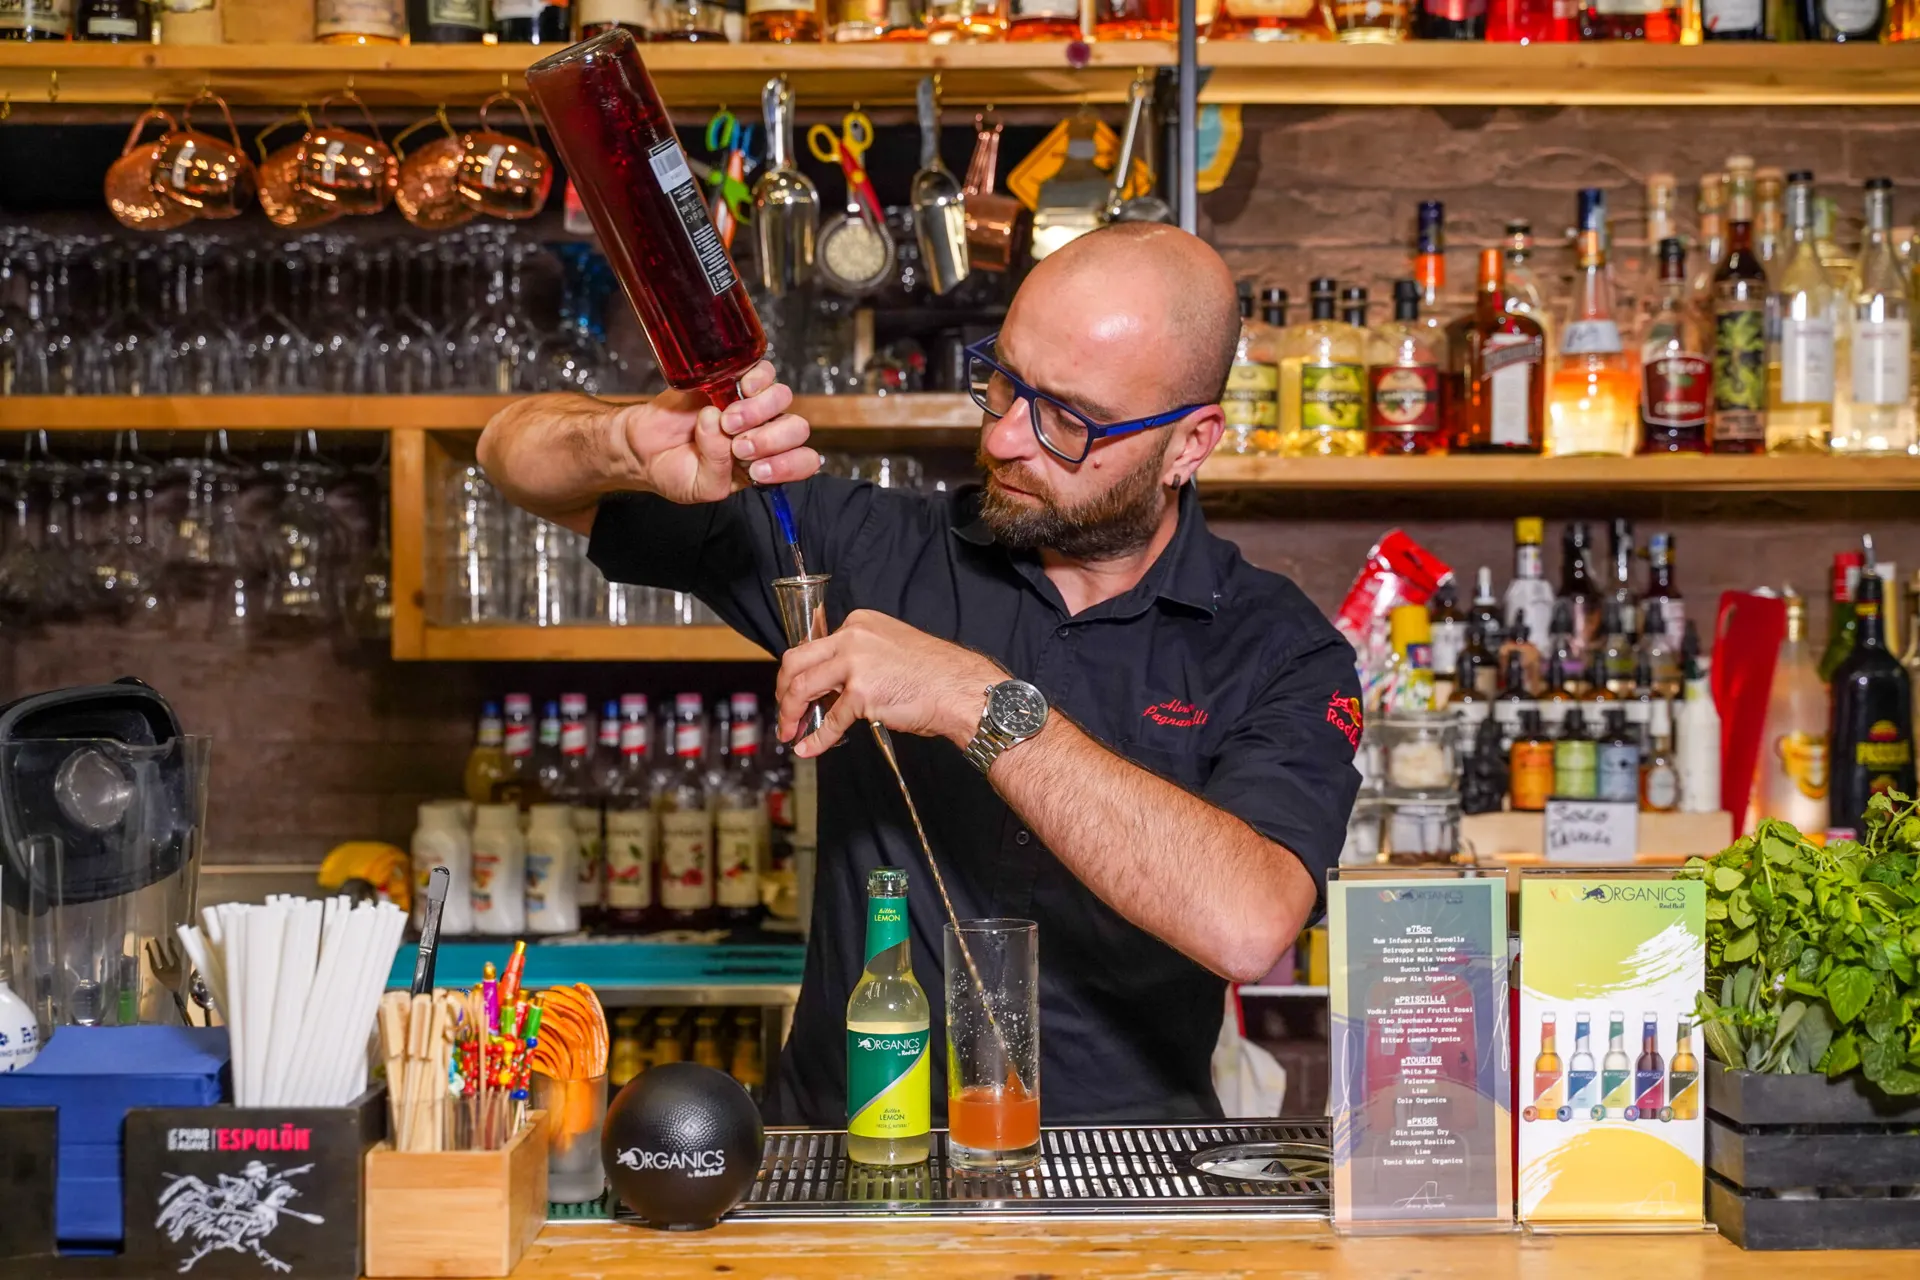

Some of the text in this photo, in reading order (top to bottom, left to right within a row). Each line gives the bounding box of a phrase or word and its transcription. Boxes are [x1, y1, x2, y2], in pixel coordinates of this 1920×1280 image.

[1596, 884, 1685, 904] ORGANICS
[874, 914, 901, 922] LEMON
[1383, 947, 1414, 955] Sciroppo
[1425, 975, 1456, 983] Organics
[865, 1037, 920, 1051] ORGANICS
[627, 1147, 725, 1171] ORGANICS
